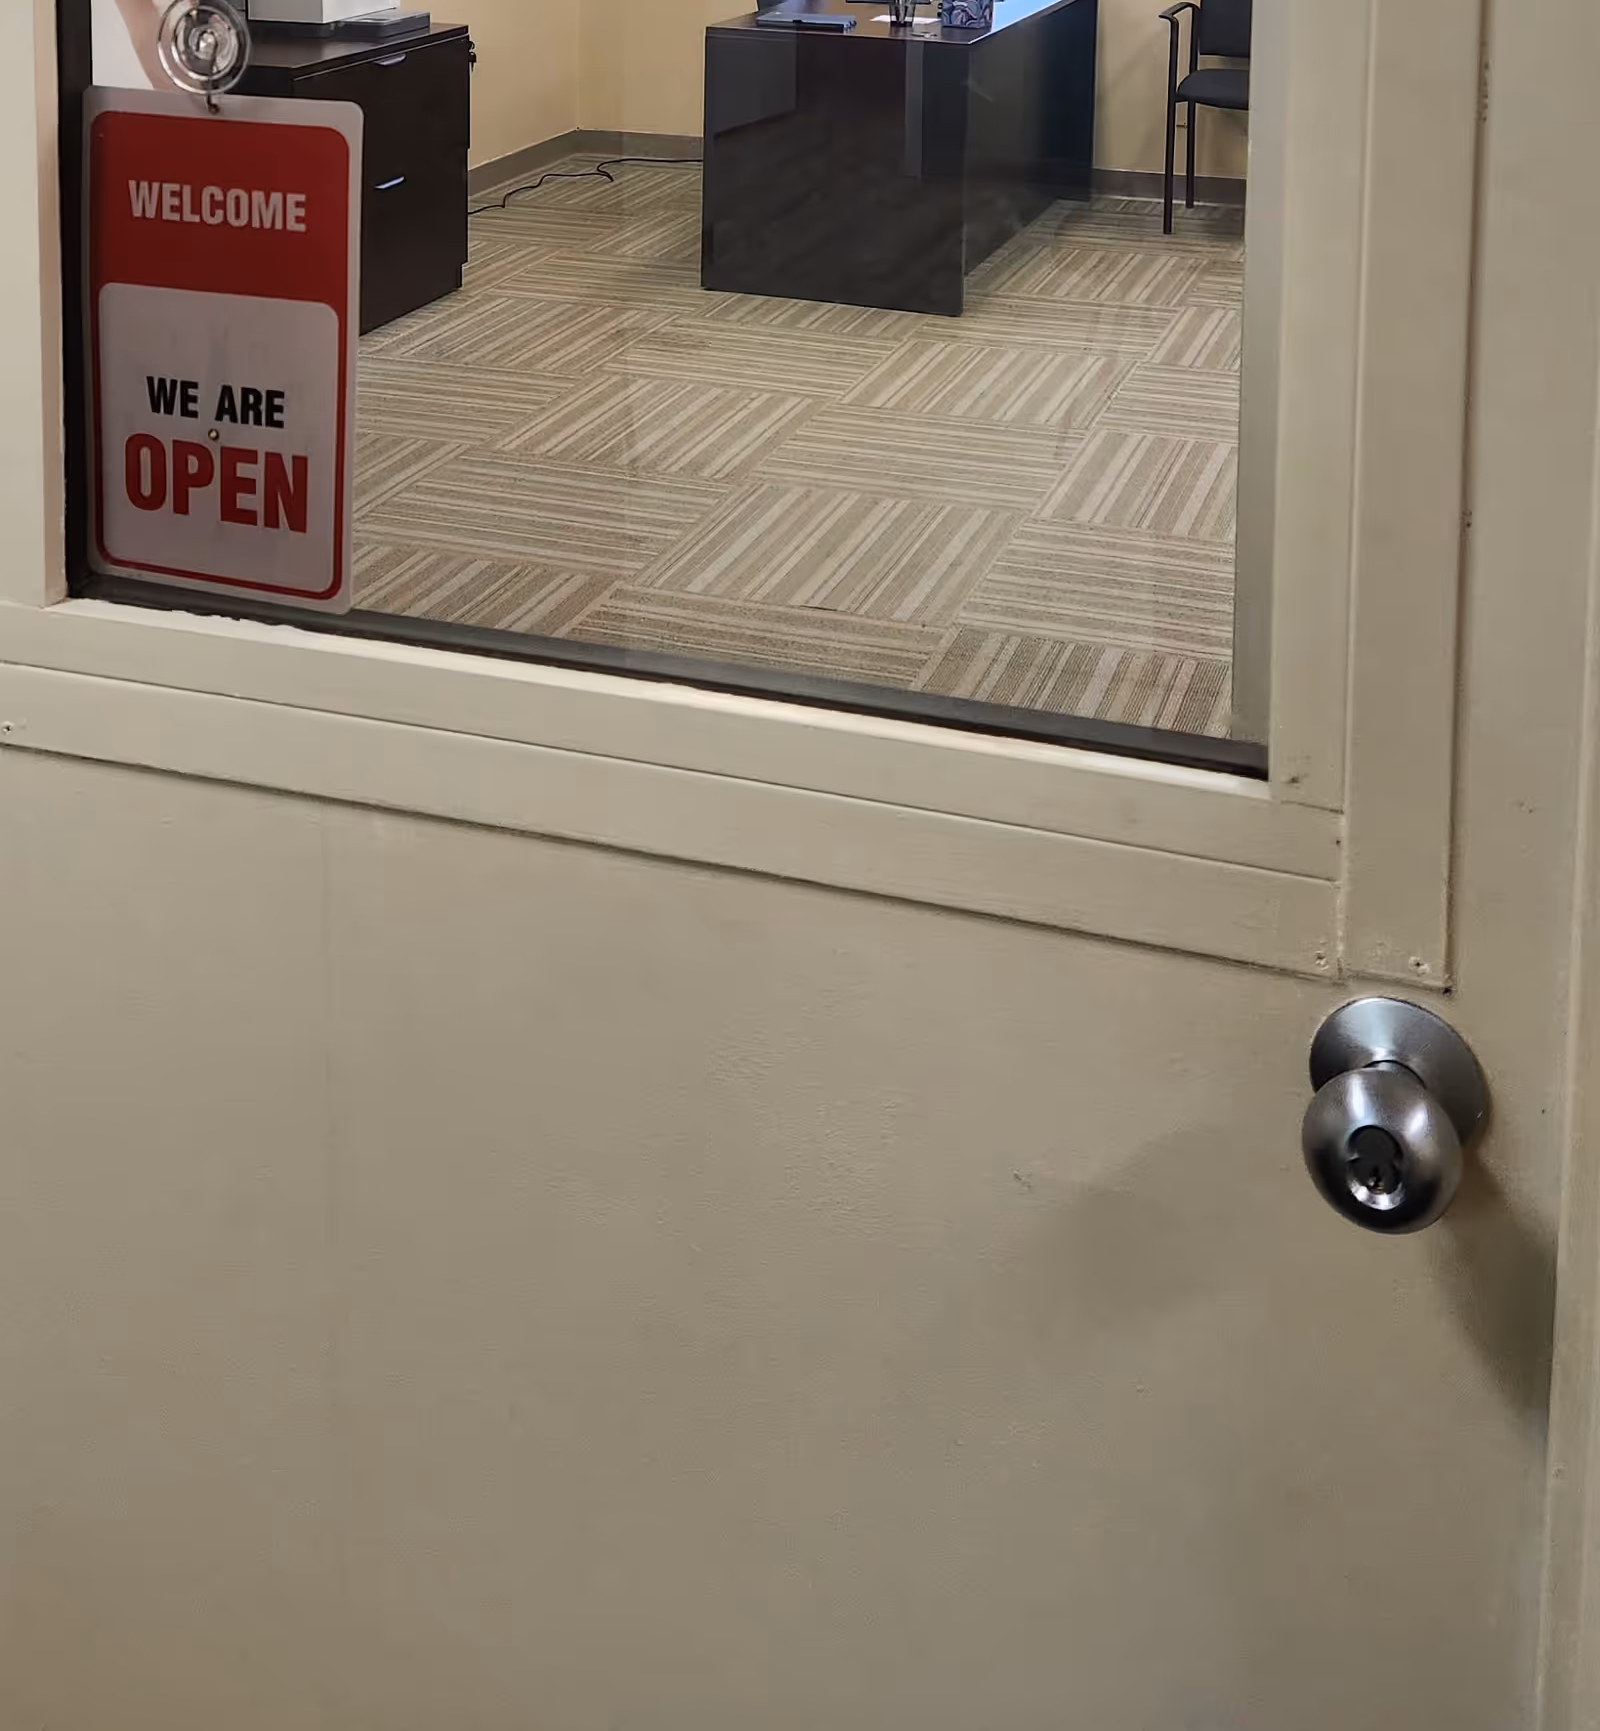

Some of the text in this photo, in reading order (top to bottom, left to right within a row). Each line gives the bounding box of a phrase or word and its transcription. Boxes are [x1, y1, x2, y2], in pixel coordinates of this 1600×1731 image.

[128, 179, 307, 233] WELCOME
[146, 375, 286, 429] WE ARE
[124, 432, 309, 535] OPEN
